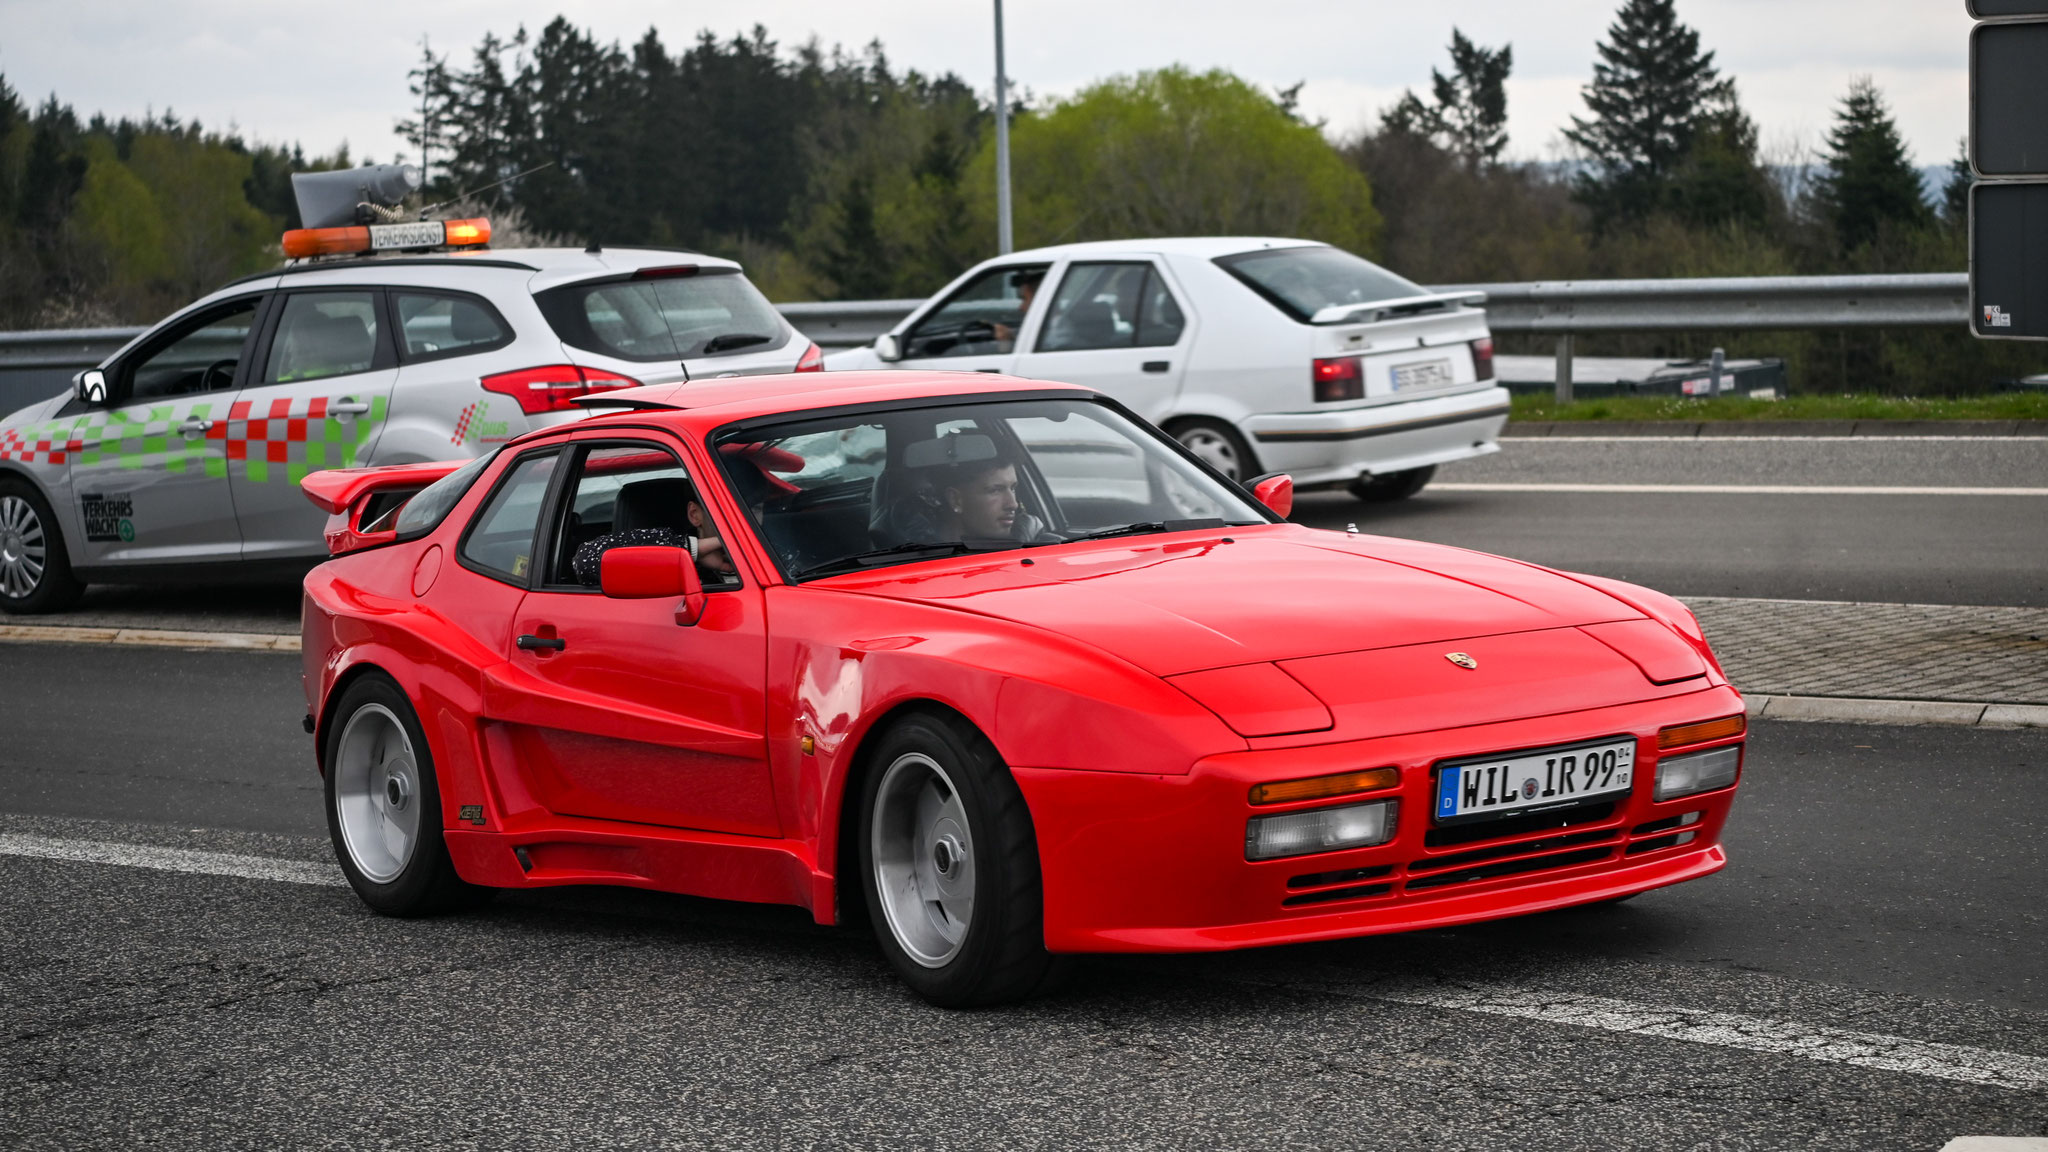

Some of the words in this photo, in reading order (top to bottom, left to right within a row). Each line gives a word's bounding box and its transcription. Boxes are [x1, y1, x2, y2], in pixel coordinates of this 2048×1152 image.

[82, 500, 133, 517] VERKEHRS
[85, 518, 119, 535] WACHT
[1463, 766, 1517, 808] WIL
[1542, 756, 1576, 797] IR
[1585, 750, 1616, 790] 99
[1617, 773, 1628, 784] 10
[1444, 798, 1452, 808] D
